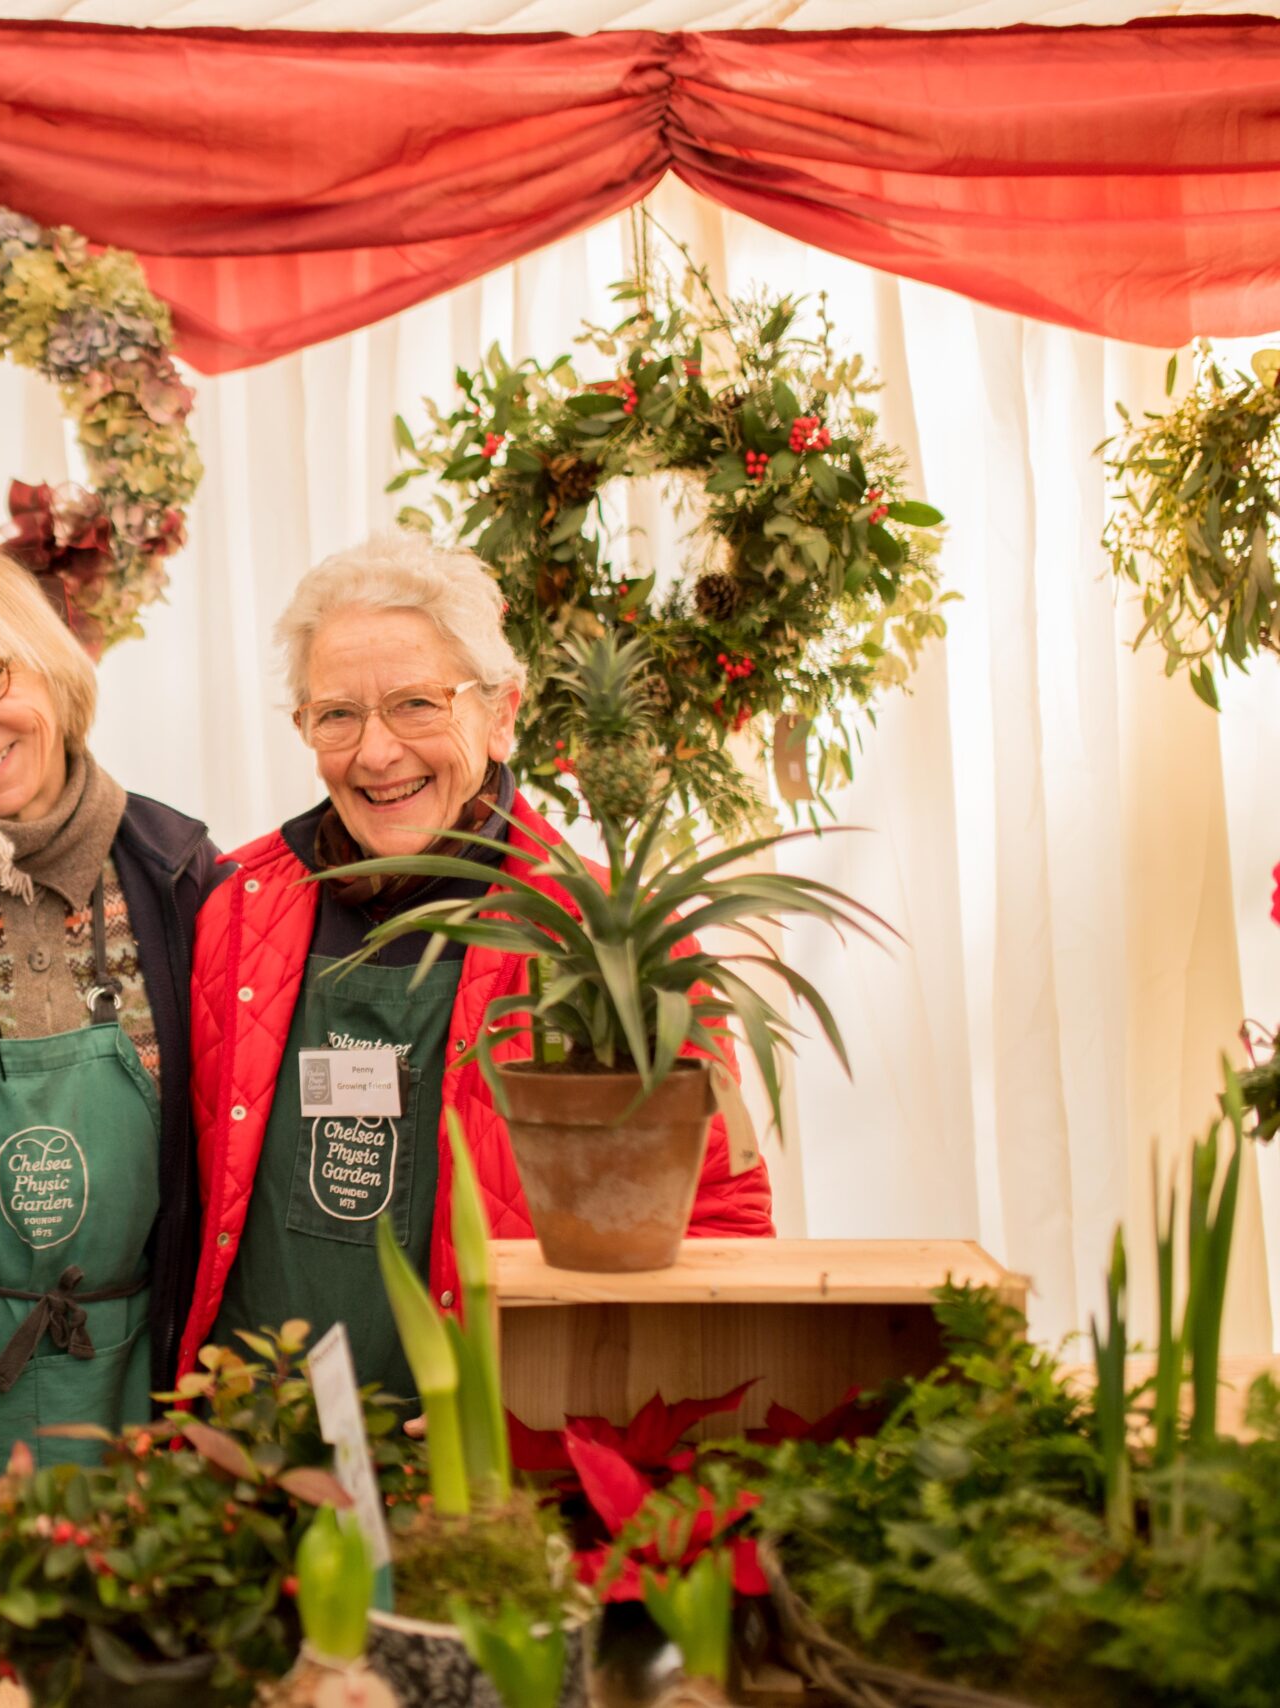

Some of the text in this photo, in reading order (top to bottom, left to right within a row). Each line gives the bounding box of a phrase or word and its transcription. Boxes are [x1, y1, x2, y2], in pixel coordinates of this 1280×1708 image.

[352, 1066, 374, 1075] Penny
[337, 1081, 392, 1091] Growing Friend
[323, 1119, 386, 1147] Chelsea
[8, 1147, 73, 1172] Chelsea
[326, 1141, 380, 1166] Physic
[321, 1161, 382, 1187] Garden
[13, 1173, 70, 1196] Physic
[329, 1184, 369, 1199] FOUNDED
[10, 1193, 75, 1212] Garden
[339, 1197, 356, 1210] 1673
[24, 1215, 63, 1225] FOUNDED
